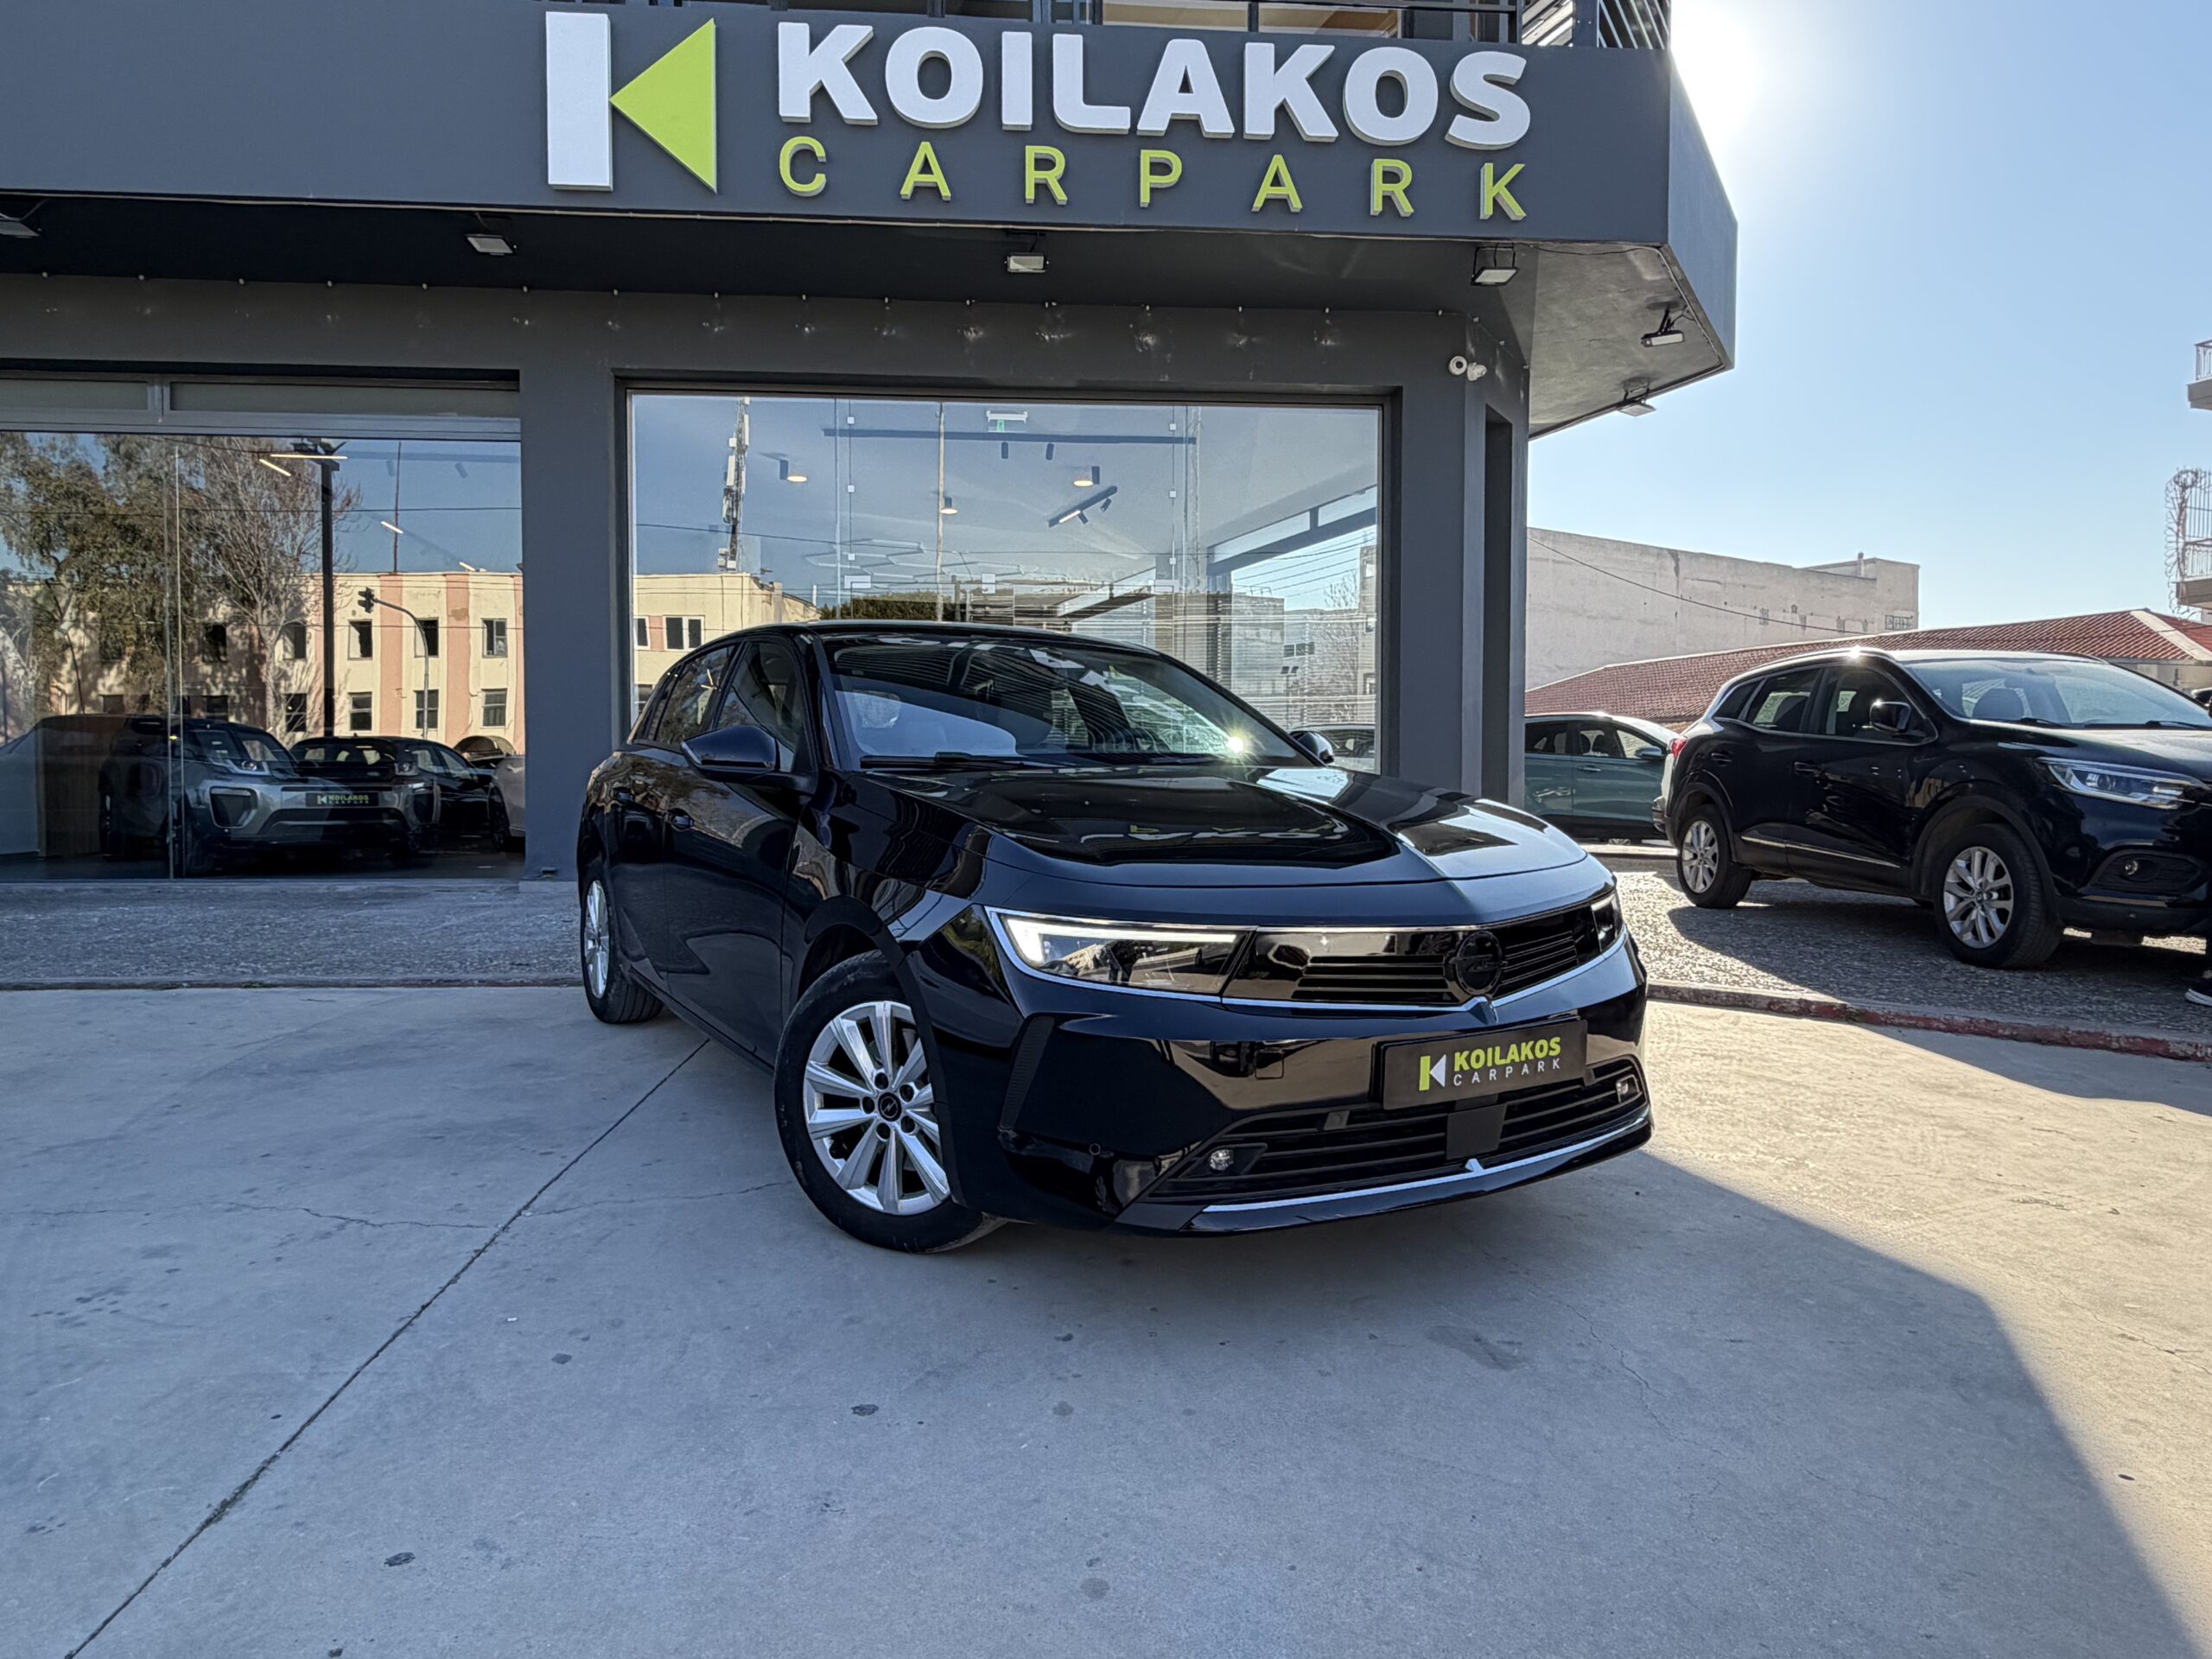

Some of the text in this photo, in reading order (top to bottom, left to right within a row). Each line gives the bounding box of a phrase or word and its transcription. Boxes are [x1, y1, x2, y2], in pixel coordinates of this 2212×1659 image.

[778, 22, 1531, 150] KOILAKOS
[779, 136, 1528, 221] CARPARK
[1453, 1037, 1561, 1071] KOILAKOS
[1453, 1058, 1560, 1086] CARPARK
